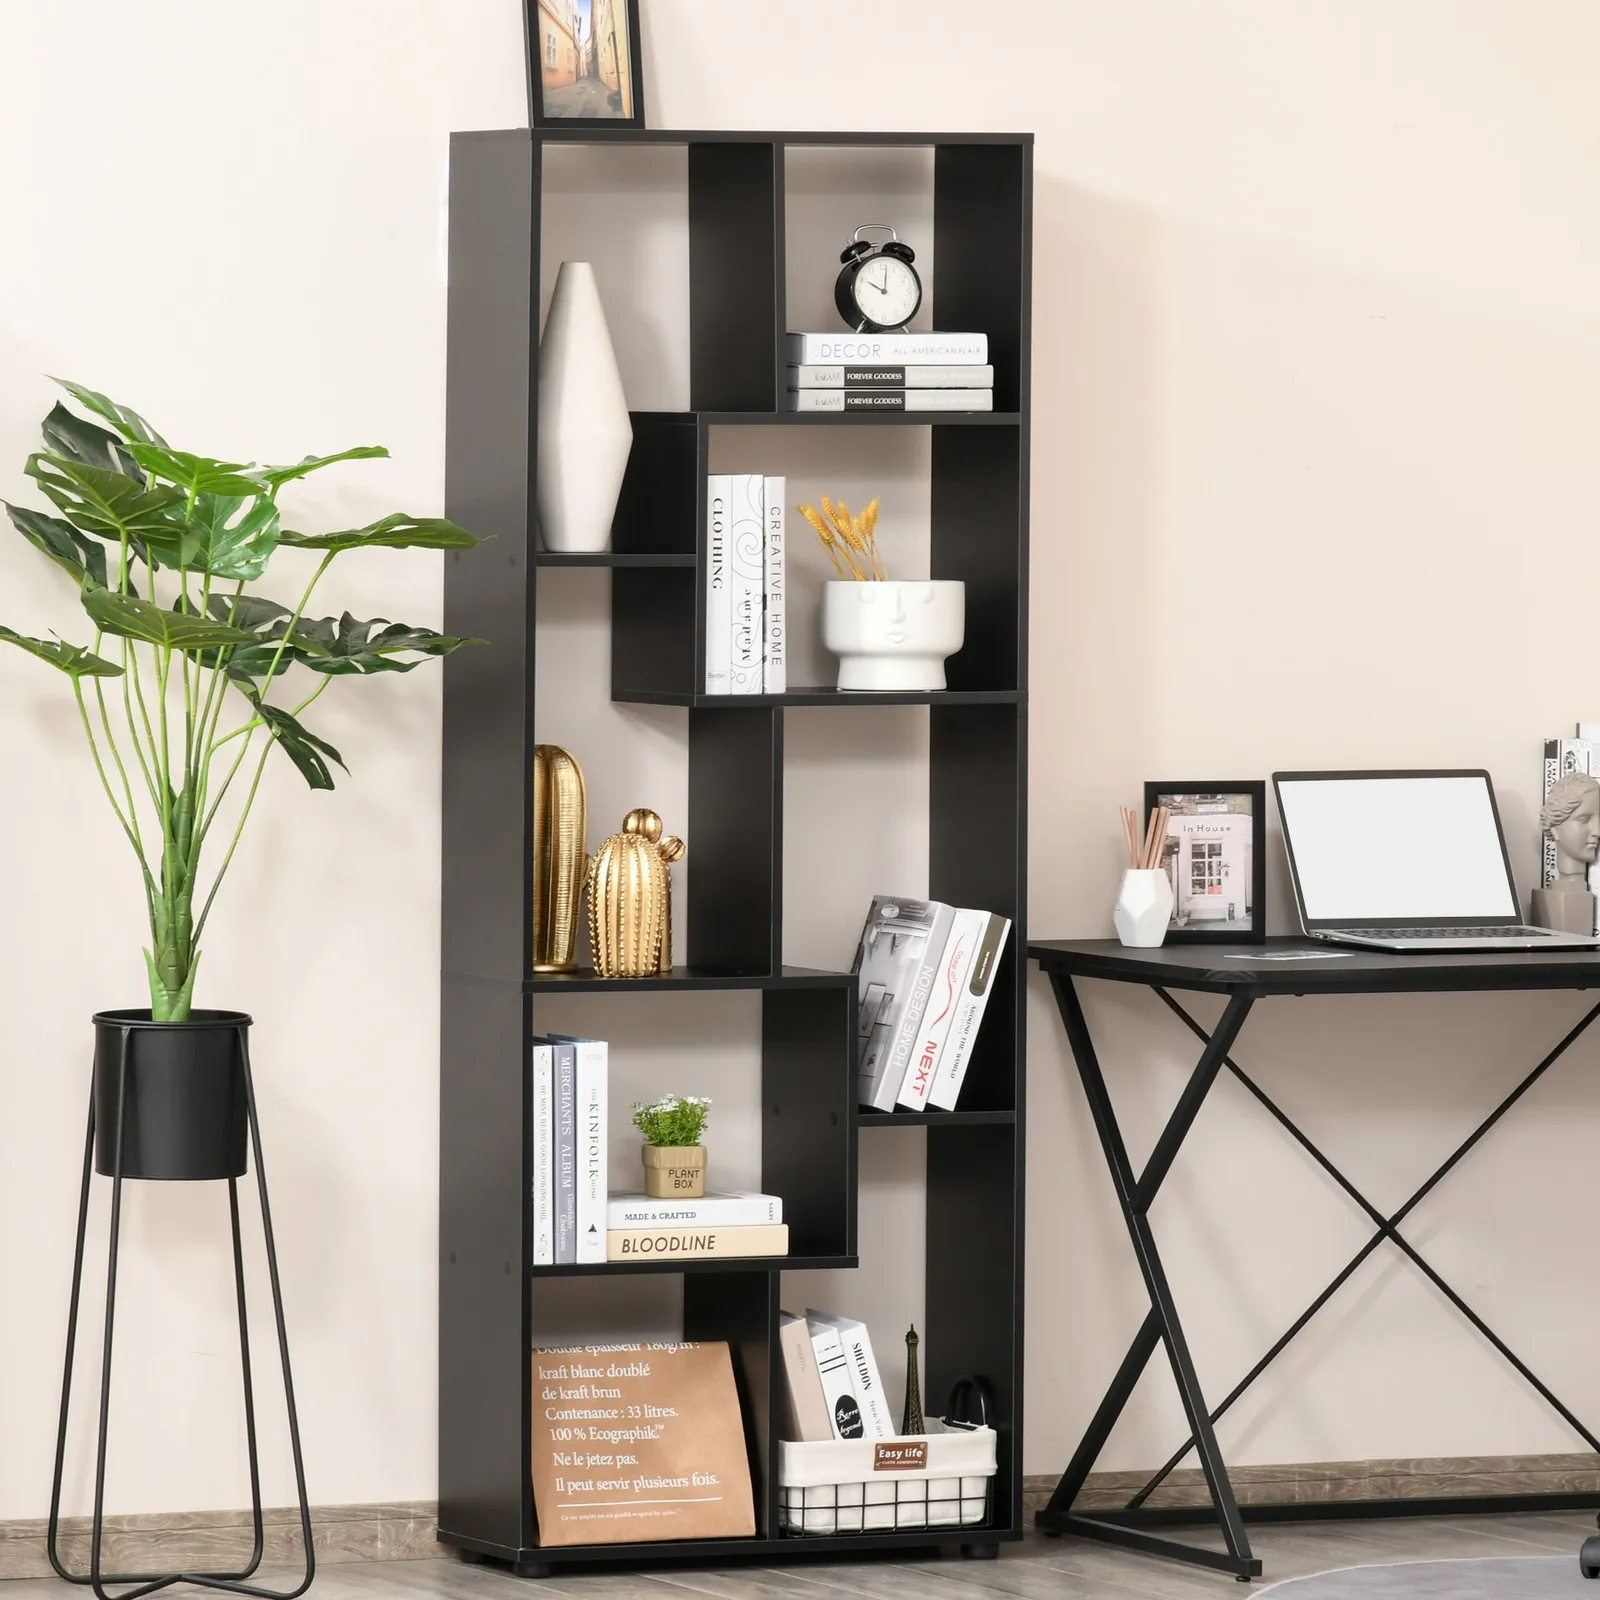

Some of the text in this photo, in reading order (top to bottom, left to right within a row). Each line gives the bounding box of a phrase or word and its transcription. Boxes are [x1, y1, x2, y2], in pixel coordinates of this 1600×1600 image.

[820, 344, 881, 358] DECOR
[712, 498, 724, 589] CLOTHING
[770, 506, 782, 666] CREATIVE HOME
[742, 589, 752, 661] Madame
[964, 1004, 976, 1035] AROUND
[893, 1023, 915, 1066] HOME
[959, 1037, 967, 1050] THE
[912, 1041, 938, 1096] NEXT
[950, 1053, 962, 1080] WORLD
[561, 1057, 571, 1136] MERCHANTS
[589, 1103, 598, 1178] KINFOLK
[562, 1144, 572, 1188] ALBUM
[668, 1169, 700, 1179] PLANT
[674, 1180, 693, 1189] BOX
[625, 1213, 649, 1221] MADE
[659, 1212, 696, 1220] CRAFTED
[621, 1235, 716, 1253] BLOODLINE
[538, 1362, 650, 1380] kraft blanc doublé
[852, 1342, 872, 1391] SHELDON
[542, 1384, 621, 1400] de kraft brun
[546, 1407, 618, 1420] Contenance
[626, 1406, 641, 1418] 33
[644, 1404, 679, 1418] litres.
[550, 1428, 572, 1441] 100
[574, 1428, 586, 1440] %
[553, 1452, 639, 1469] Ne le jetez pas.
[879, 1448, 923, 1460] Easy life
[555, 1472, 719, 1495] Il peut servir plusieurs fois.
